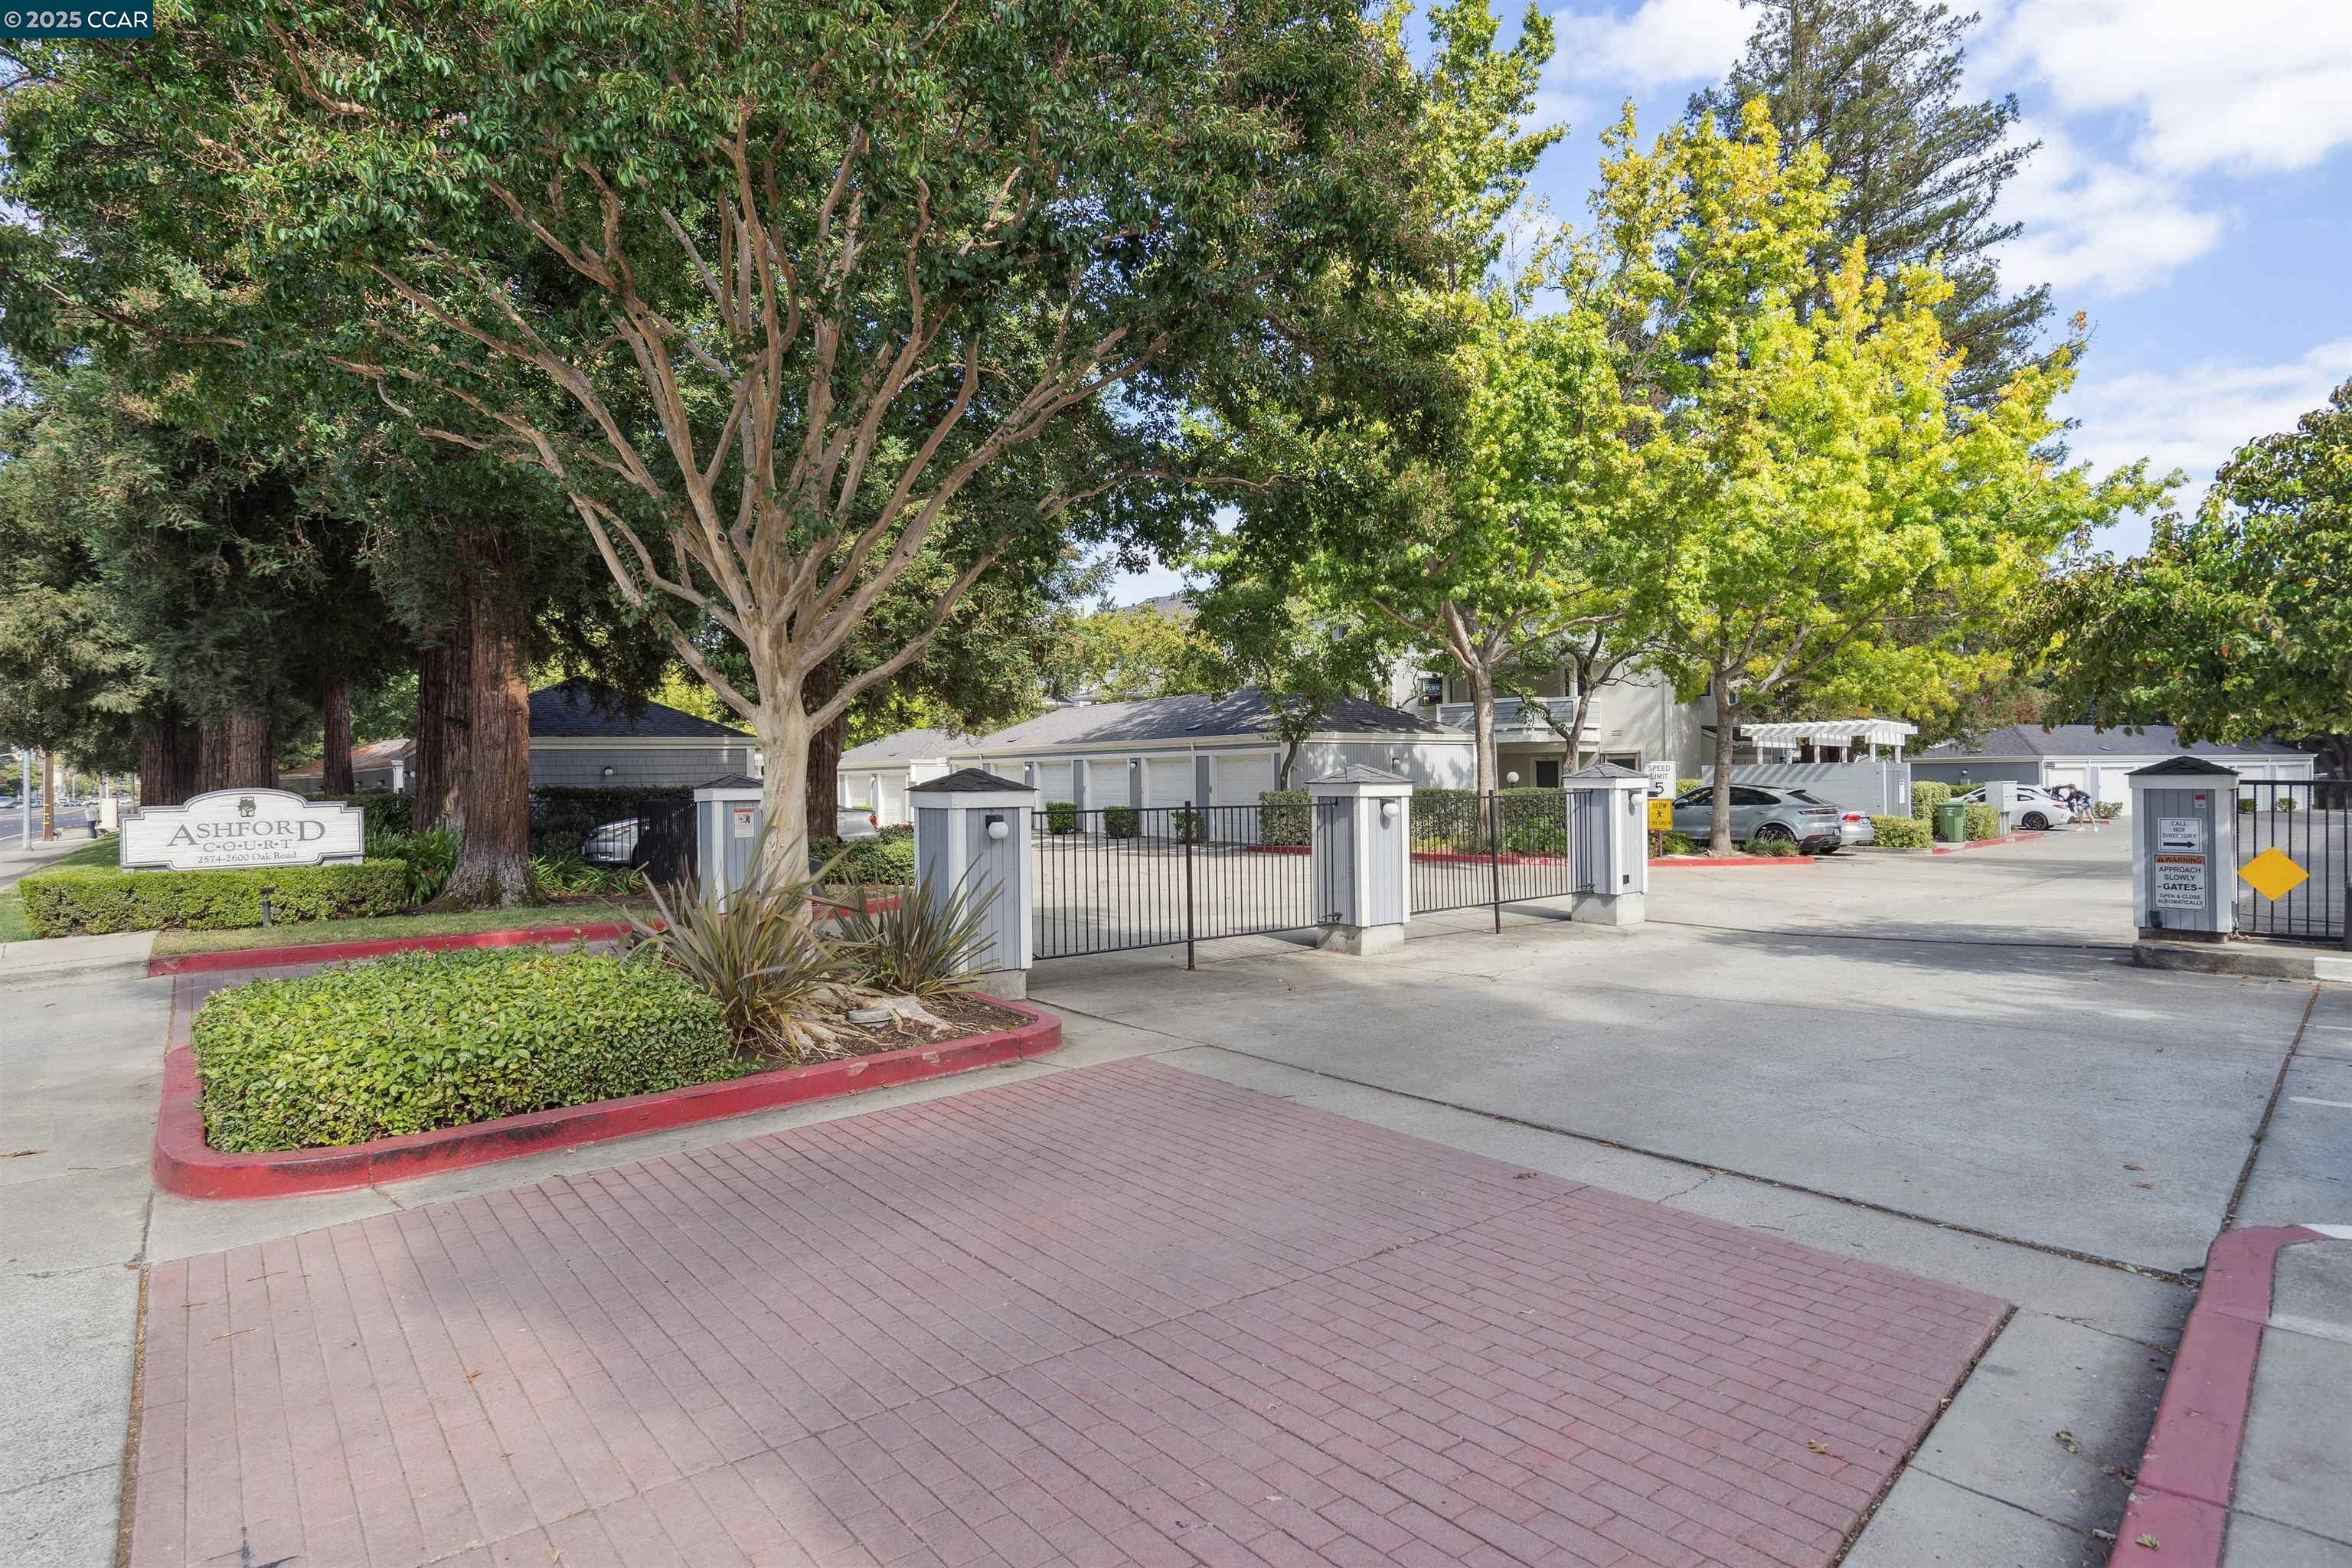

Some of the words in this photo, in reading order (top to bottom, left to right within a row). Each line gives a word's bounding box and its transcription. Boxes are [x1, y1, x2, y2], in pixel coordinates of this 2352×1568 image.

[1655, 782, 1664, 795] 5
[167, 820, 326, 848] ASHFORD
[198, 854, 250, 864] 2574-2600
[252, 852, 271, 861] Oak
[273, 851, 297, 860] Road
